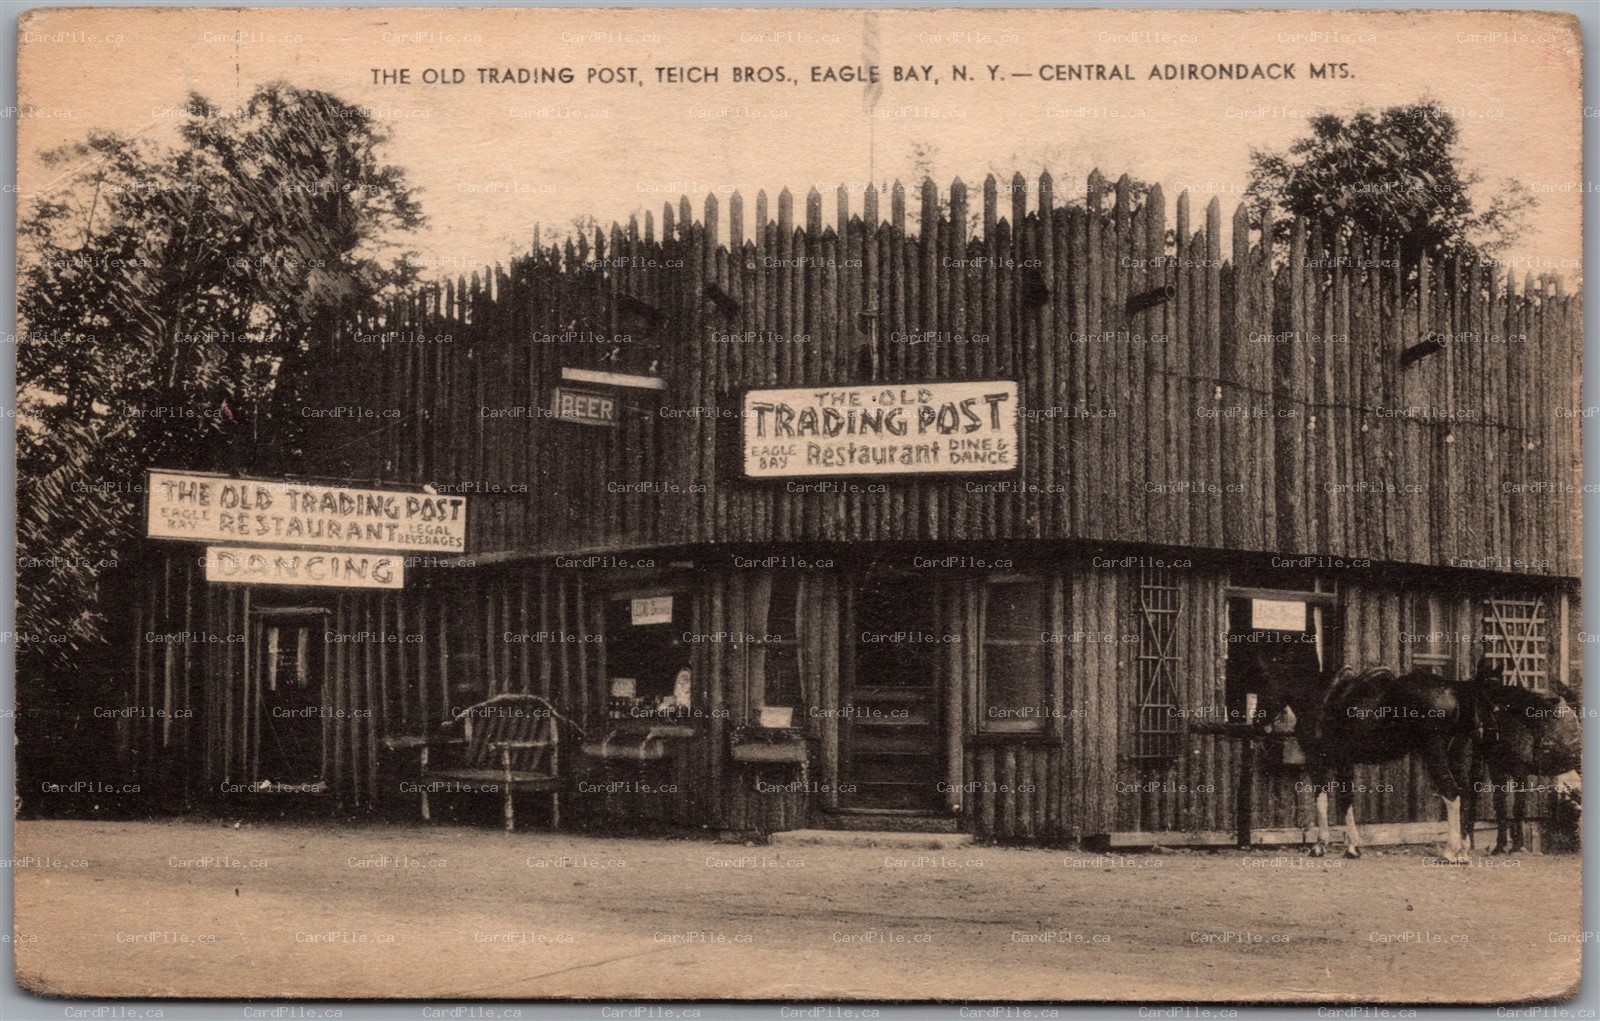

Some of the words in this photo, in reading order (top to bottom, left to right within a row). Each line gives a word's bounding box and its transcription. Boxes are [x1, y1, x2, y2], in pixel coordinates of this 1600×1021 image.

[815, 391, 862, 406] THE
[879, 389, 933, 406] OLD
[561, 393, 614, 420] BEER
[752, 401, 907, 438] TRADING
[918, 392, 1009, 434] POST
[751, 445, 797, 456] EAGLE
[949, 438, 991, 450] DINE
[997, 438, 1008, 450] &
[807, 441, 940, 467] Restaurant
[949, 450, 1009, 464] DANCE
[760, 457, 788, 469] BAY
[161, 480, 209, 506] THE
[221, 485, 273, 510] OLD
[285, 489, 400, 519] TRADING
[406, 496, 463, 522] POST
[161, 507, 210, 520] EAGLE
[168, 519, 198, 529] BAY
[220, 512, 399, 542] RESTAURANT
[409, 523, 451, 535] LEGAL
[398, 534, 463, 545] BEVERAGES
[217, 552, 393, 584] DANCING
